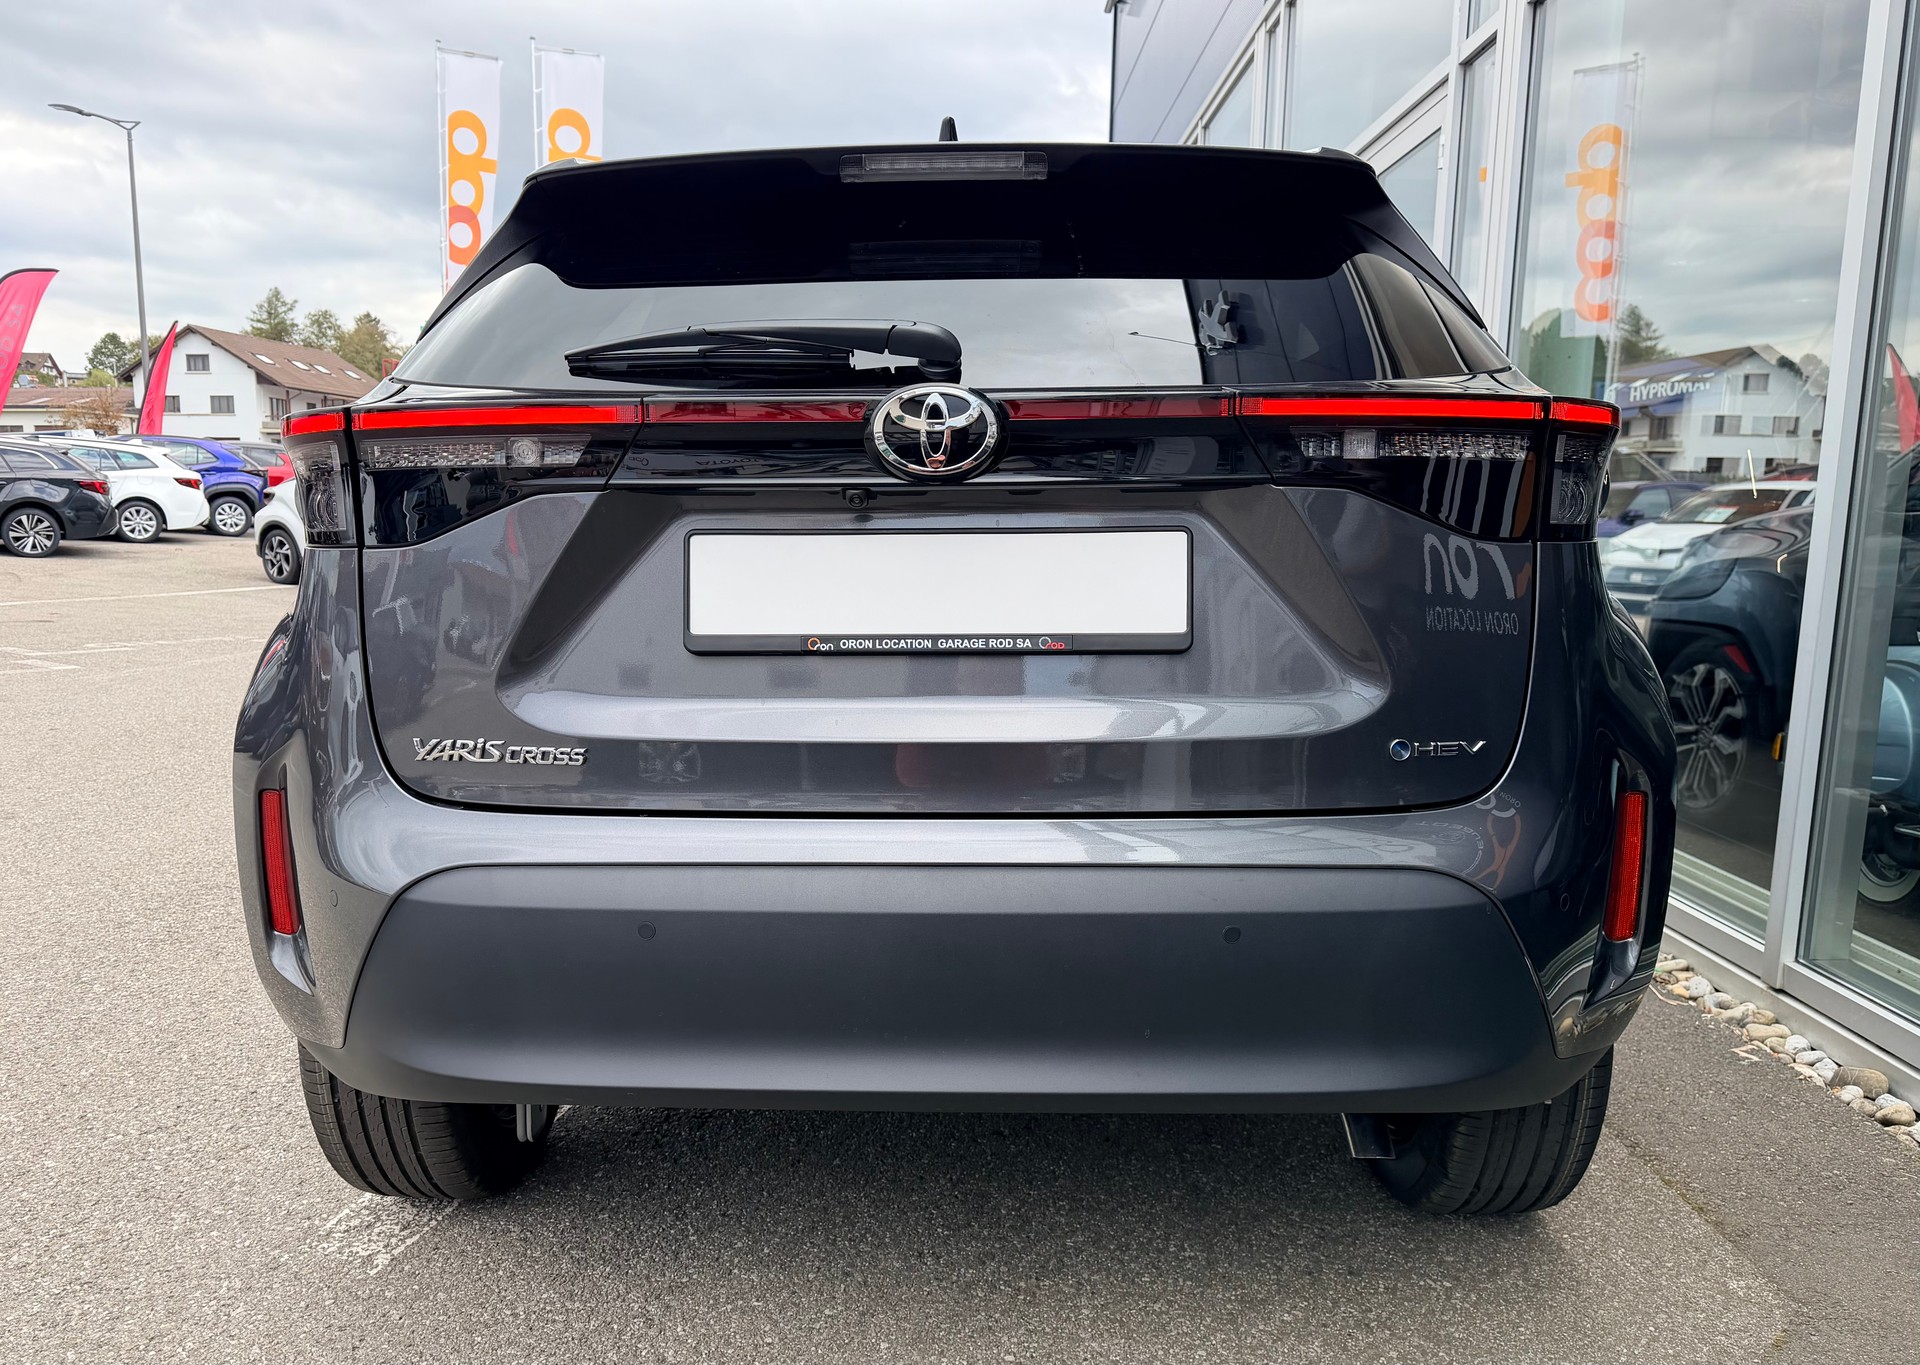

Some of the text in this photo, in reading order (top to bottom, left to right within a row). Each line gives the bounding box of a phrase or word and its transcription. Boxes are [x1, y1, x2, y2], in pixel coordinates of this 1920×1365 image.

[447, 109, 498, 264] oop
[840, 639, 873, 649] ORON
[876, 639, 932, 649] LOCATION
[938, 638, 986, 649] GARAGE
[989, 638, 1013, 648] ROD
[1016, 638, 1032, 648] SA
[413, 737, 588, 767] YARIS CROSS
[1413, 740, 1487, 756] HEV
